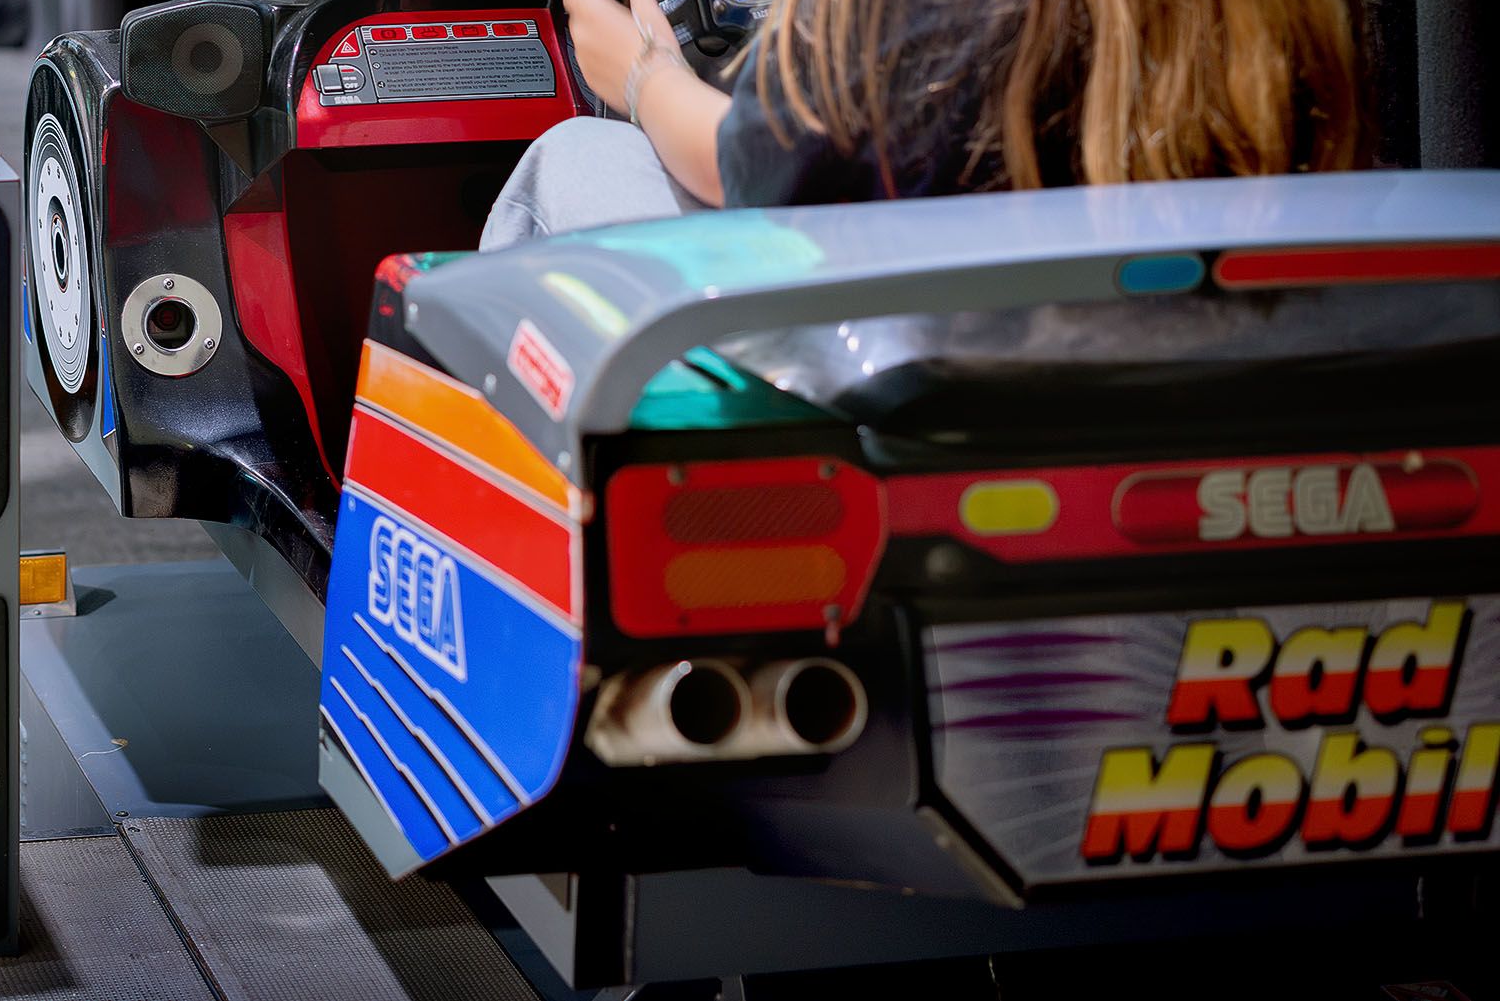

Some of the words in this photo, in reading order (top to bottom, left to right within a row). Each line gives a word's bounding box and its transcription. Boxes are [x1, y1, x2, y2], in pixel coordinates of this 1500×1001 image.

[1196, 462, 1396, 542] SEGA
[368, 515, 469, 685] SEGA
[1167, 600, 1474, 737] Rad
[1078, 721, 1500, 866] Mobil
